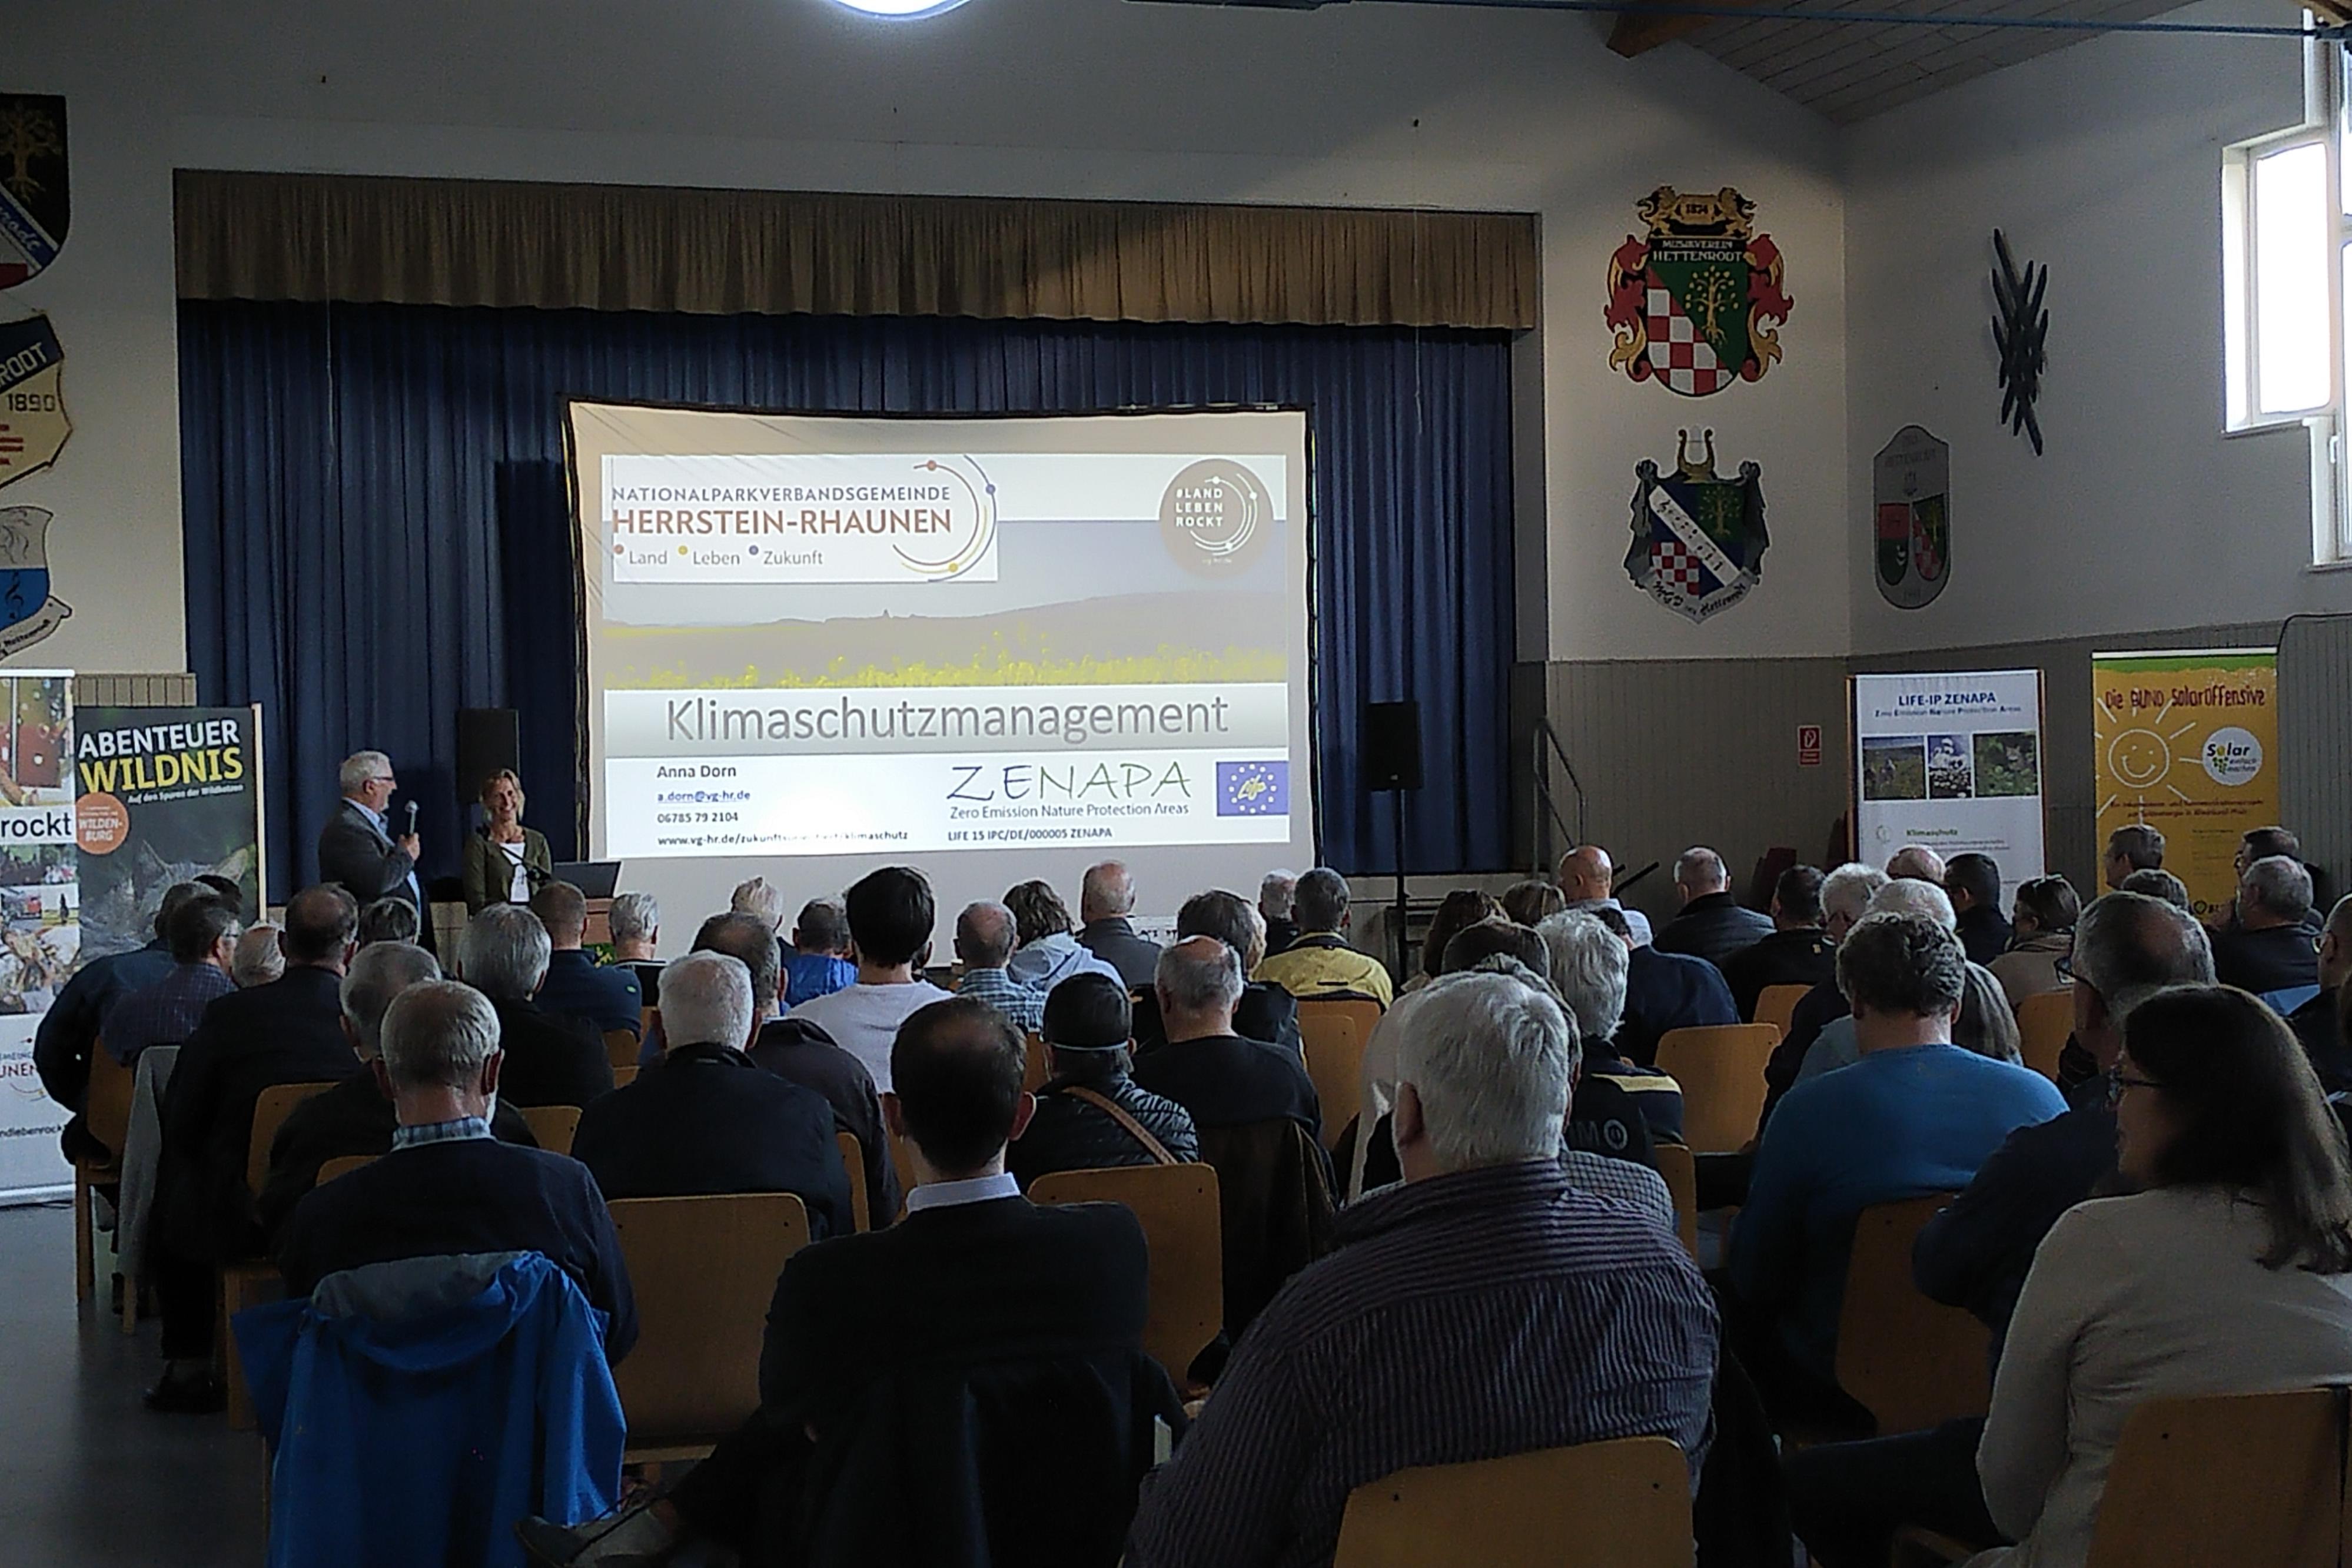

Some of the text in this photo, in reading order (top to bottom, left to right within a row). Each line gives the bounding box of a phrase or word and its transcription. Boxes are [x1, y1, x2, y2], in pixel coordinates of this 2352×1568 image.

[8, 393, 55, 411] 1890
[612, 487, 951, 501] NATIONALPARKVERBANDSGEMEINDE
[1175, 503, 1223, 513] LEBEN
[612, 509, 951, 534] HERRSTEIN-RHAUNEN
[1175, 516, 1223, 527] ROCKT
[629, 550, 823, 565] Land Leben Zukunft
[1898, 692, 1996, 706] LIFE-IP ZENAPA
[2105, 688, 2123, 709] Die
[668, 696, 1228, 745] Klimaschutzmanagement
[78, 719, 240, 759] ABENTEUER
[2207, 742, 2250, 756] Solar
[79, 747, 244, 793] WILDNIS
[657, 765, 736, 778] Anna Dorn
[946, 760, 1191, 801] ZENAPA
[657, 813, 692, 823] 06785
[695, 812, 708, 822] 79
[950, 803, 1190, 819] Zero Emission Nature Protection Areas
[1, 812, 72, 838] rockt
[85, 829, 114, 842] BURG
[948, 831, 969, 841] LIFE
[972, 830, 985, 841] 15
[1070, 828, 1112, 838] ZENAPA
